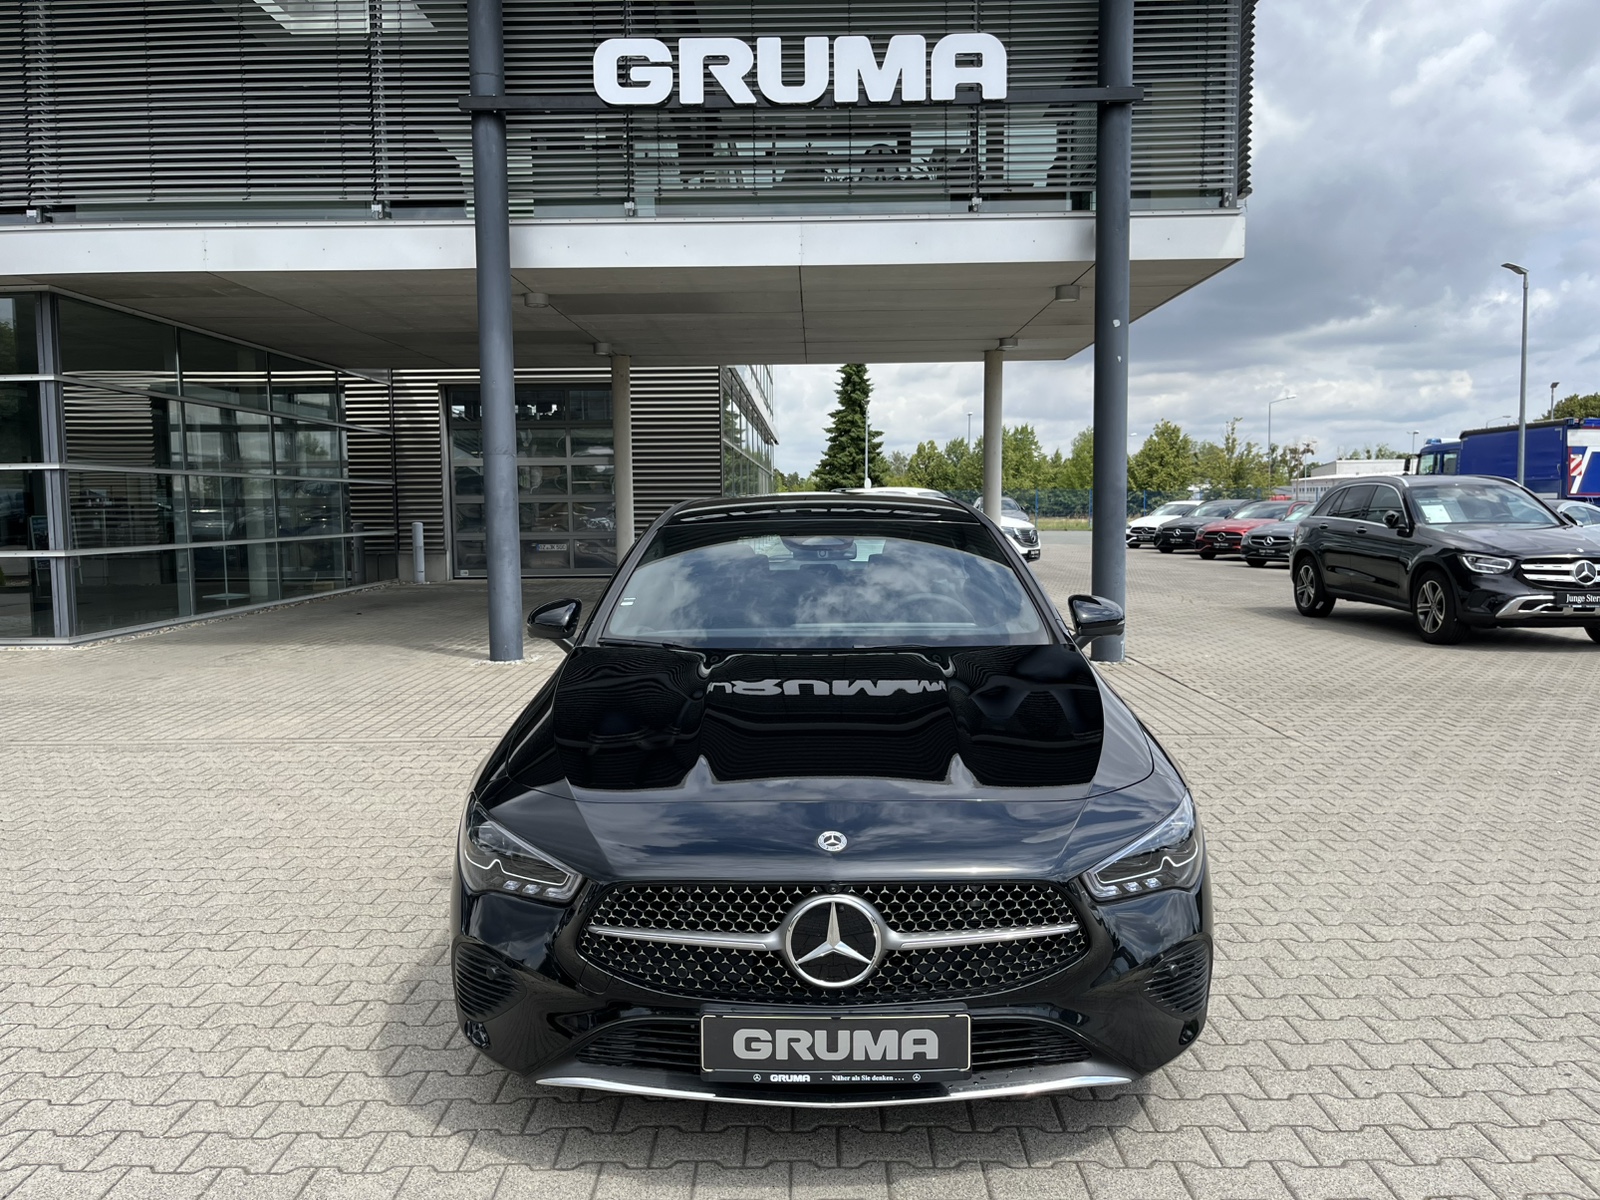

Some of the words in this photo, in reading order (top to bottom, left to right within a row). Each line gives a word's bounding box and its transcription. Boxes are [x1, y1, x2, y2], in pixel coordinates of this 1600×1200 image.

[593, 33, 1007, 105] GRUMA
[1566, 594, 1586, 604] Junge
[733, 1028, 939, 1061] GRUMA
[769, 1074, 811, 1083] GRUMA
[831, 1074, 851, 1082] Näher
[851, 1074, 861, 1082] als
[861, 1074, 871, 1082] Sie
